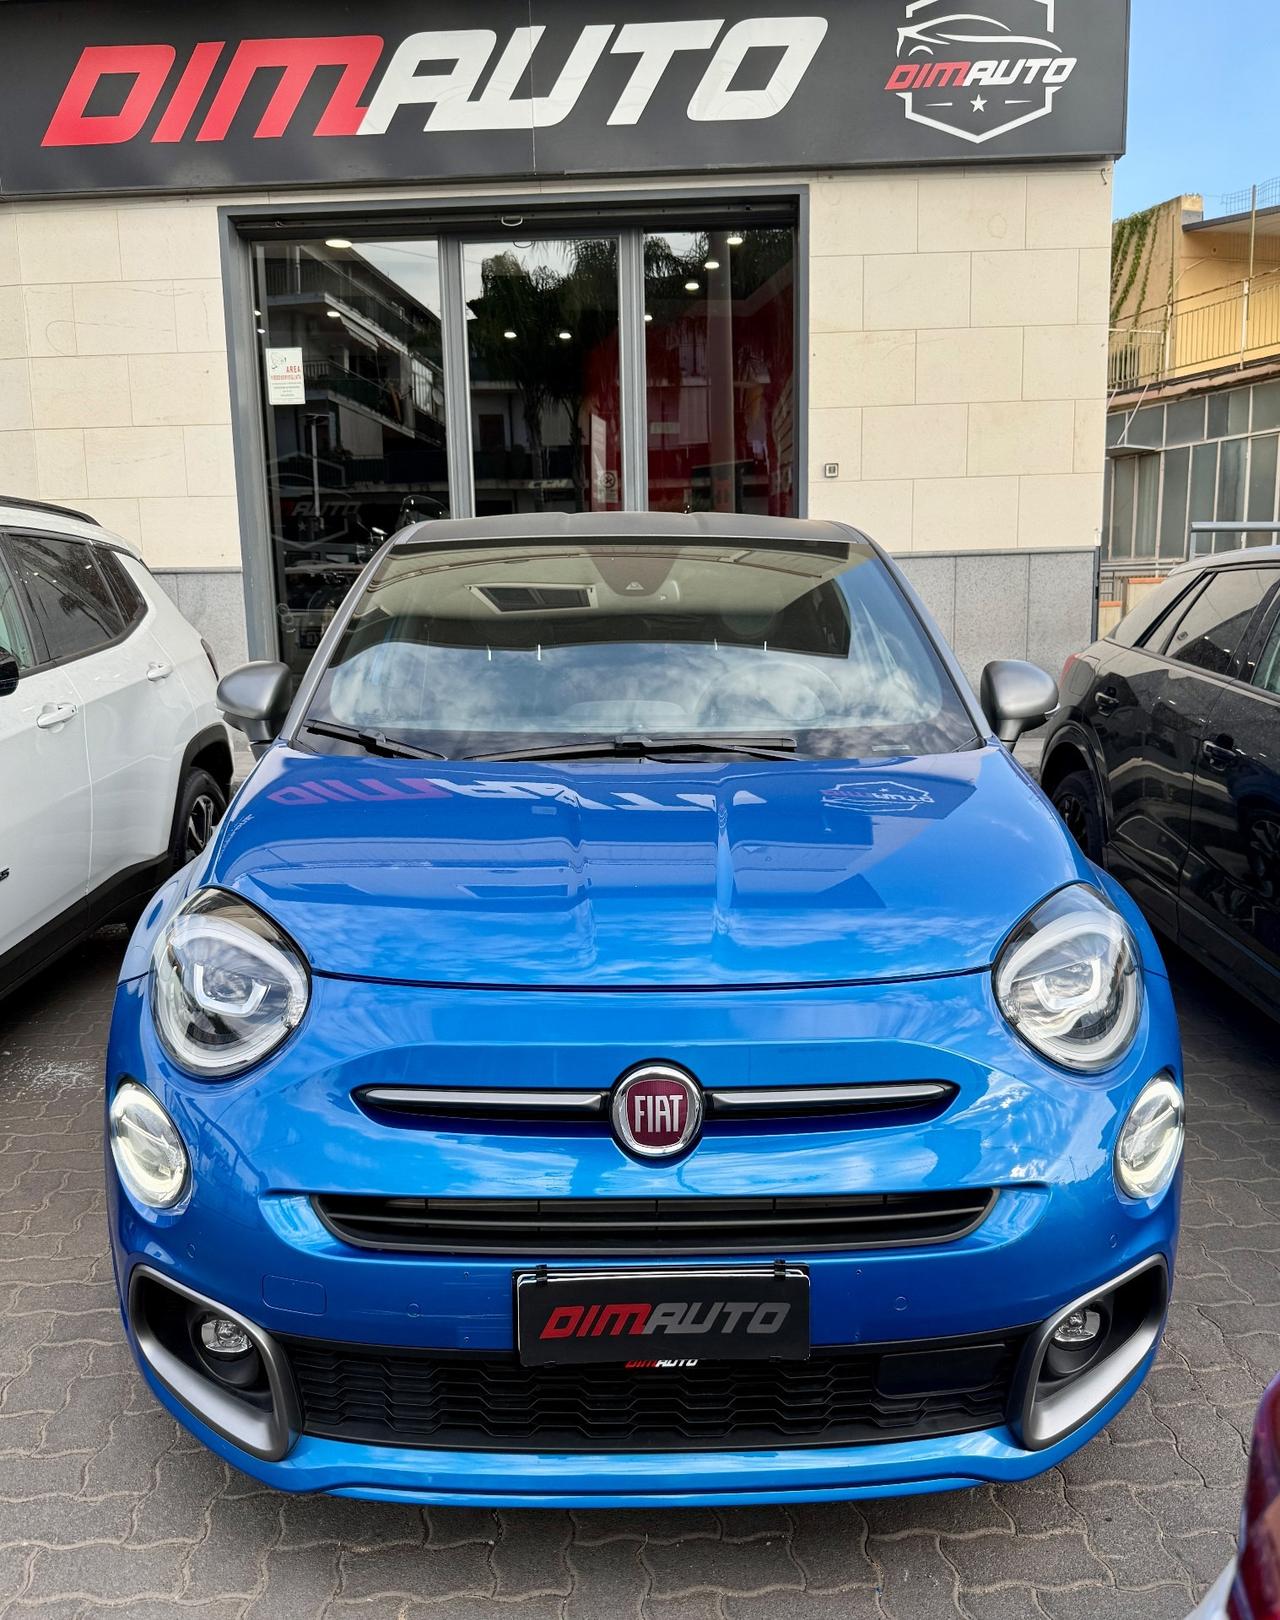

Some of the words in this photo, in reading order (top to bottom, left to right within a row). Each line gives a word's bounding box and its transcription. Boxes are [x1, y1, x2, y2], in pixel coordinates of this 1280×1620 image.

[41, 16, 829, 147] DIMAUTO
[884, 57, 1077, 90] DIMAUTO
[634, 1094, 684, 1133] FIAT
[539, 1302, 791, 1340] DIMAUTO
